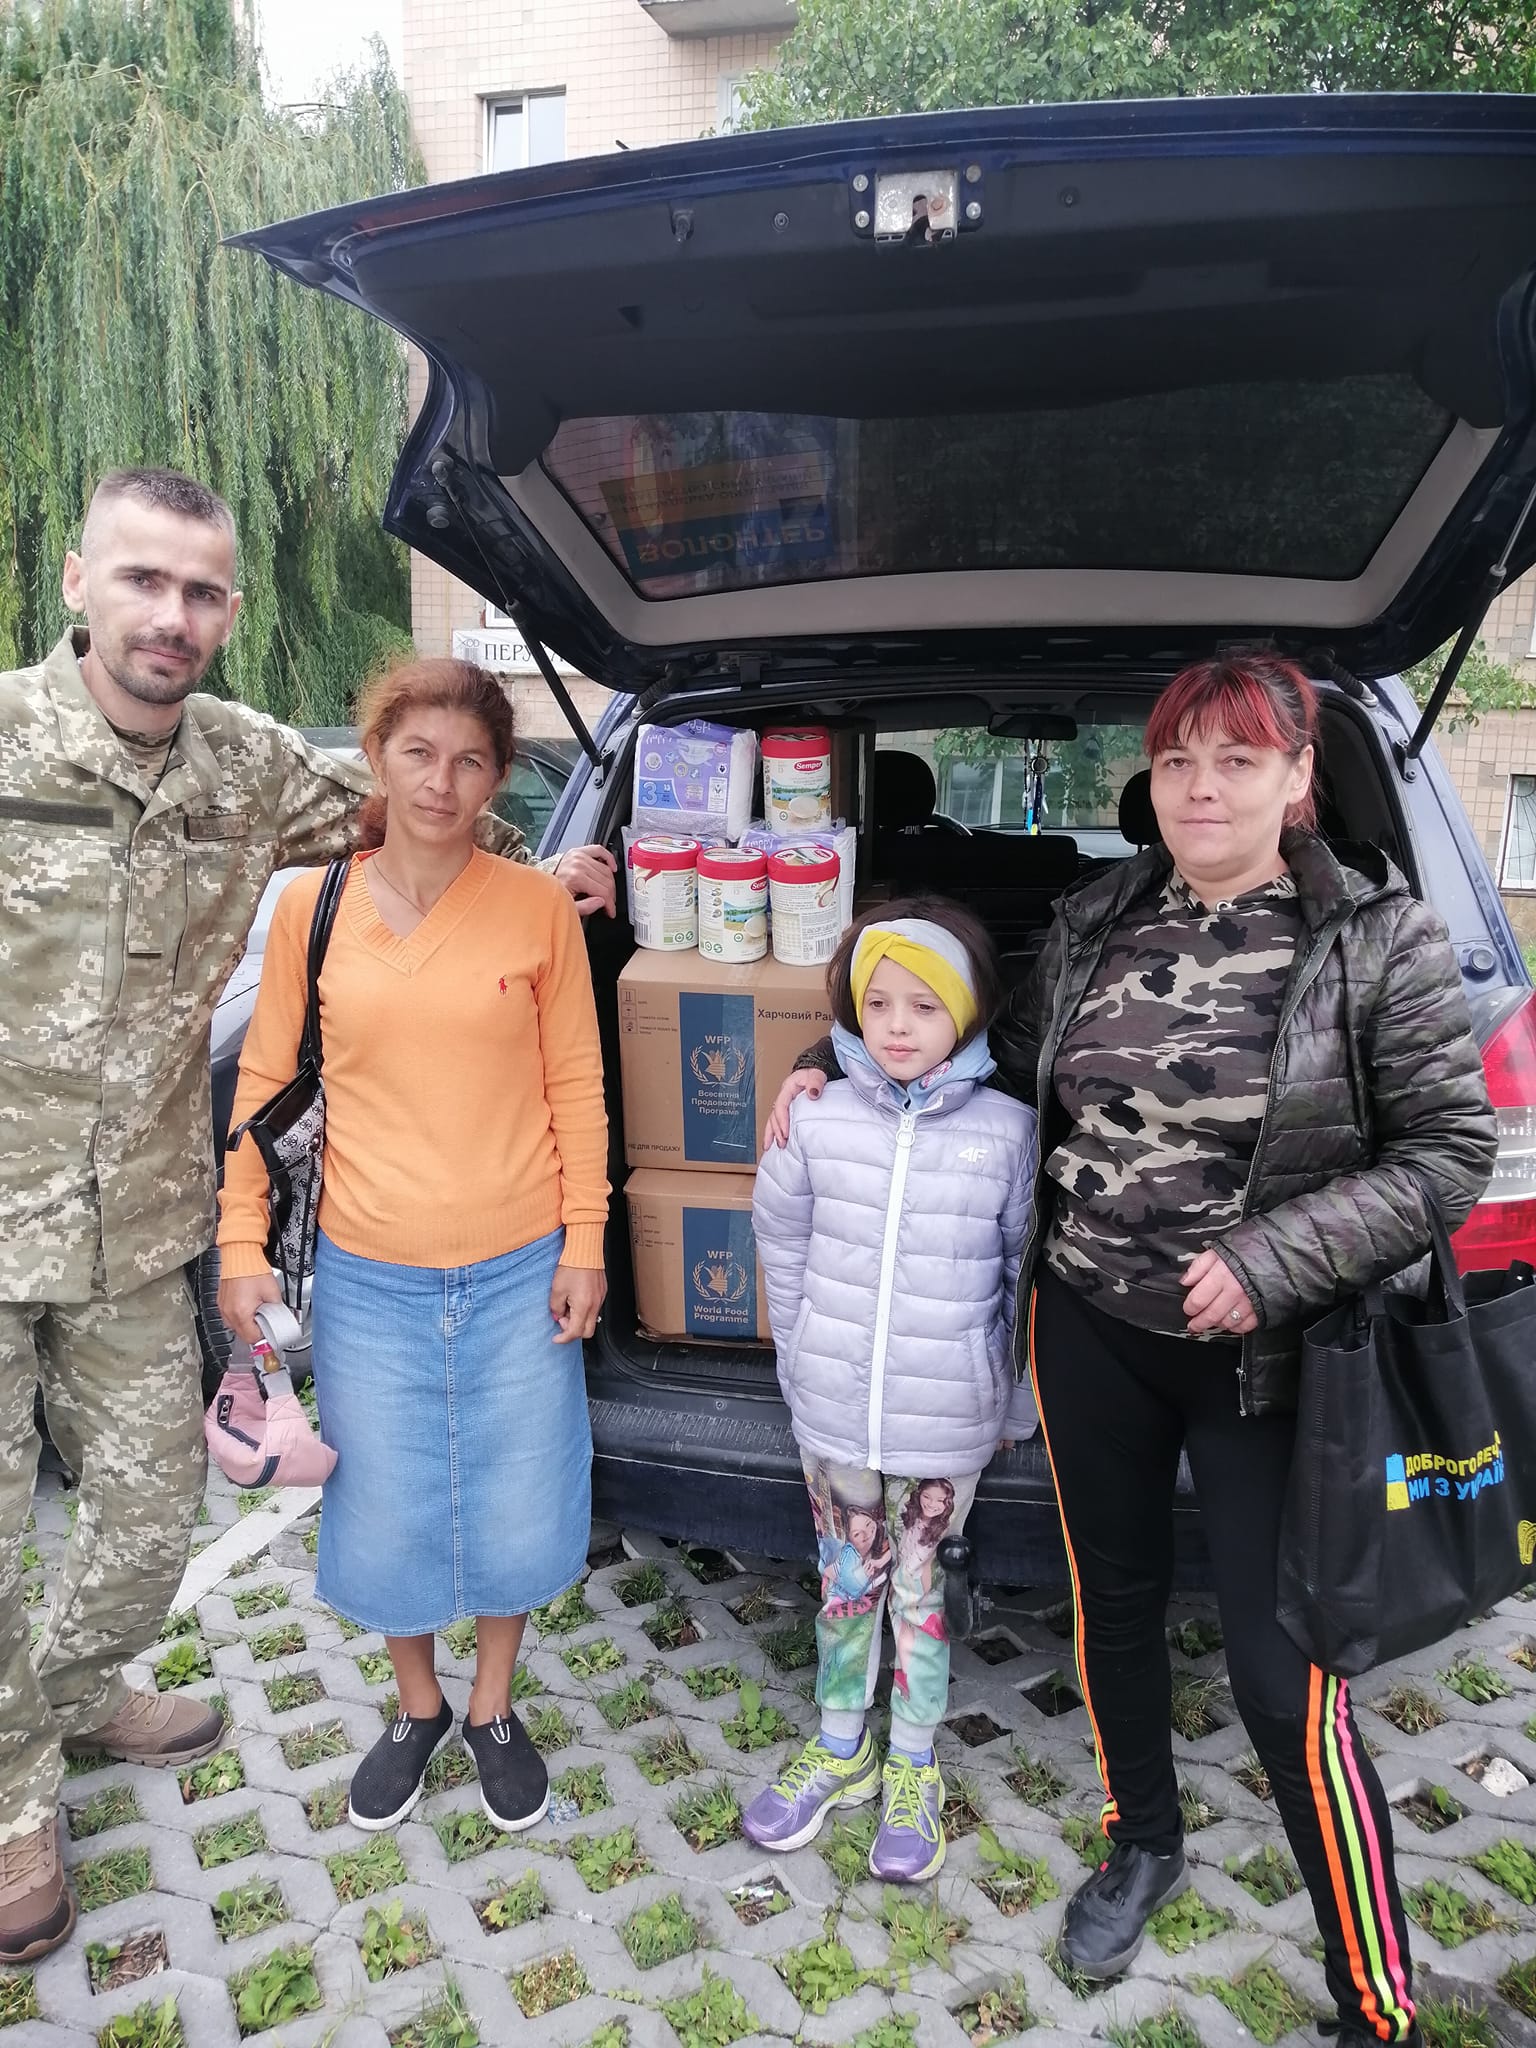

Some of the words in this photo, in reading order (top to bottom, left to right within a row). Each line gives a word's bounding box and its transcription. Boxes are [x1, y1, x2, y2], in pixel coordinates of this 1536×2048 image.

[484, 643, 564, 662] ПЕРУ
[795, 761, 823, 772] Semper
[643, 781, 657, 806] 3
[758, 1008, 812, 1021] Харчовий
[705, 1034, 731, 1045] WFP
[699, 1106, 740, 1116] Програма
[637, 1143, 650, 1151] ДЛЯ
[651, 1144, 681, 1152] ПРОДАЖУ
[958, 1147, 989, 1163] 4F
[707, 1250, 733, 1260] WFP
[693, 1304, 722, 1315] World
[725, 1306, 749, 1316] Food
[694, 1312, 749, 1324] Programme
[1408, 1477, 1431, 1502] МИ
[1434, 1477, 1450, 1497] З
